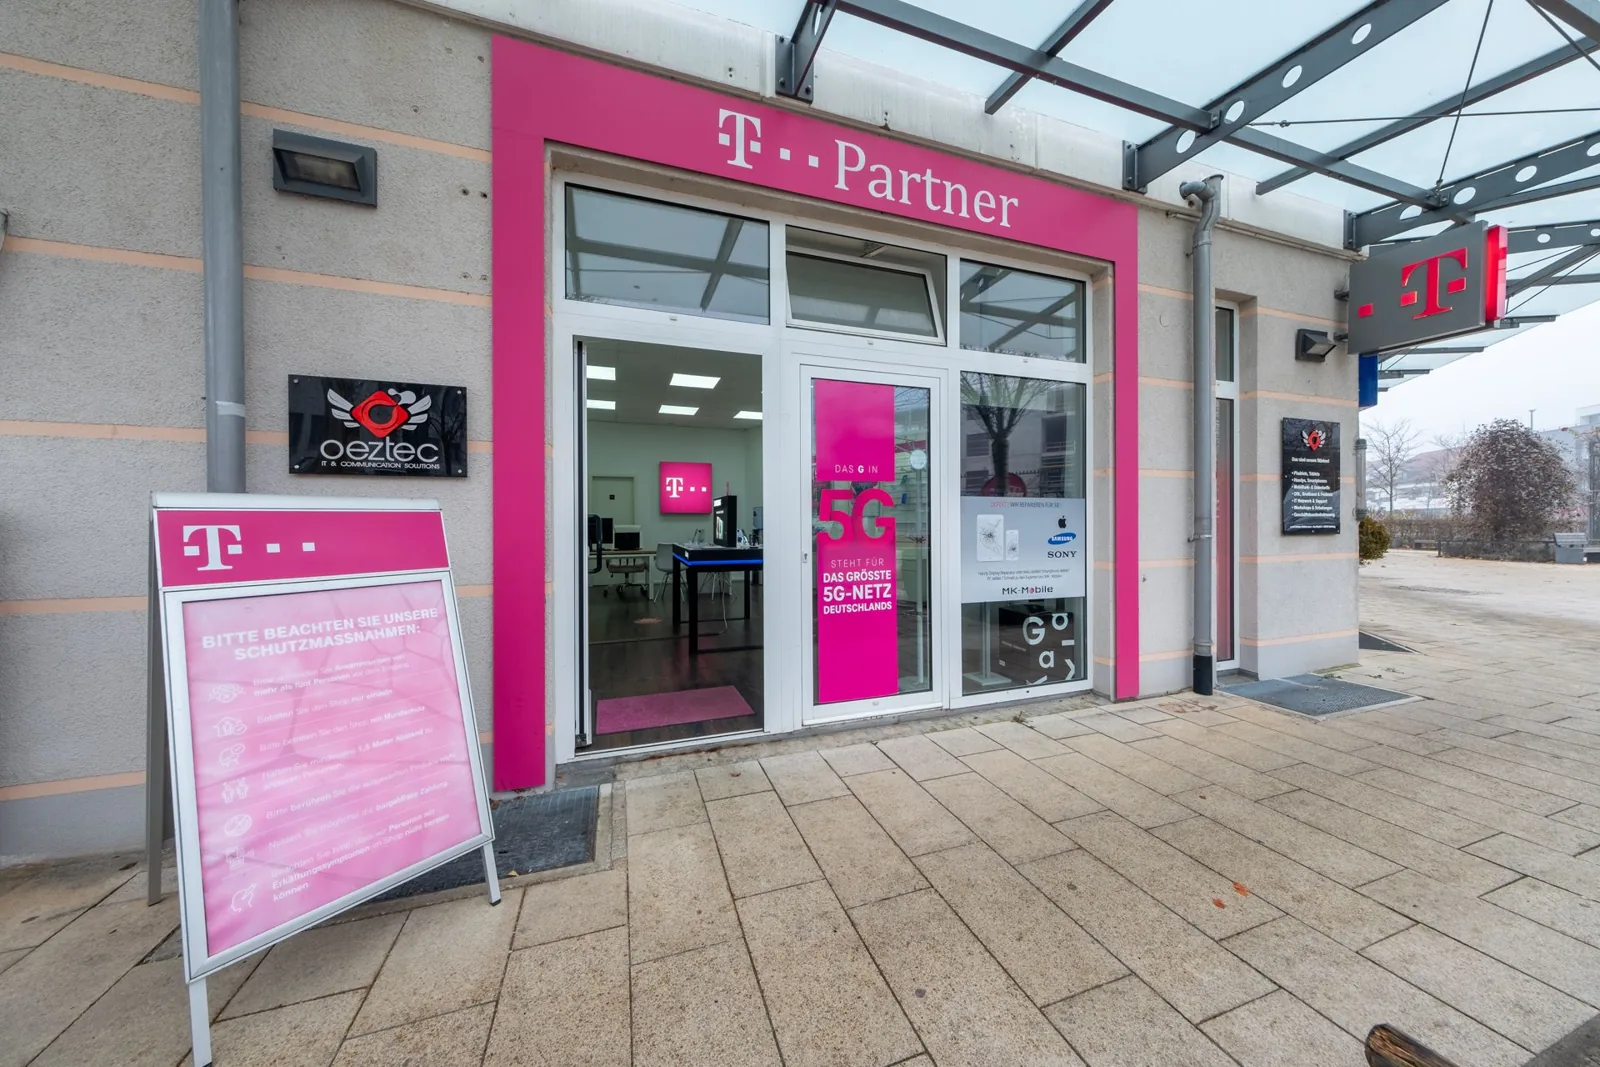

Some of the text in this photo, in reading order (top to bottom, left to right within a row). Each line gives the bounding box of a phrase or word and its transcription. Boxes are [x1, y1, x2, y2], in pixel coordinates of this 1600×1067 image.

[718, 108, 1018, 228] T Partner
[320, 436, 440, 462] oeztec
[834, 464, 878, 474] DAS G IN
[816, 488, 896, 545] 5G
[182, 524, 242, 571] T
[831, 557, 884, 568] STEHT FÜR
[823, 569, 892, 583] DAS GRÖSSTE
[823, 583, 892, 602] 5G-NETZ
[1002, 586, 1053, 595] MK-Mobile
[824, 601, 892, 614] DEUTSCHLANDS
[201, 607, 438, 648] BITTE BEACHTEN SIE UNSERE
[233, 623, 420, 660] SCHUTZMASSNAHMEN:
